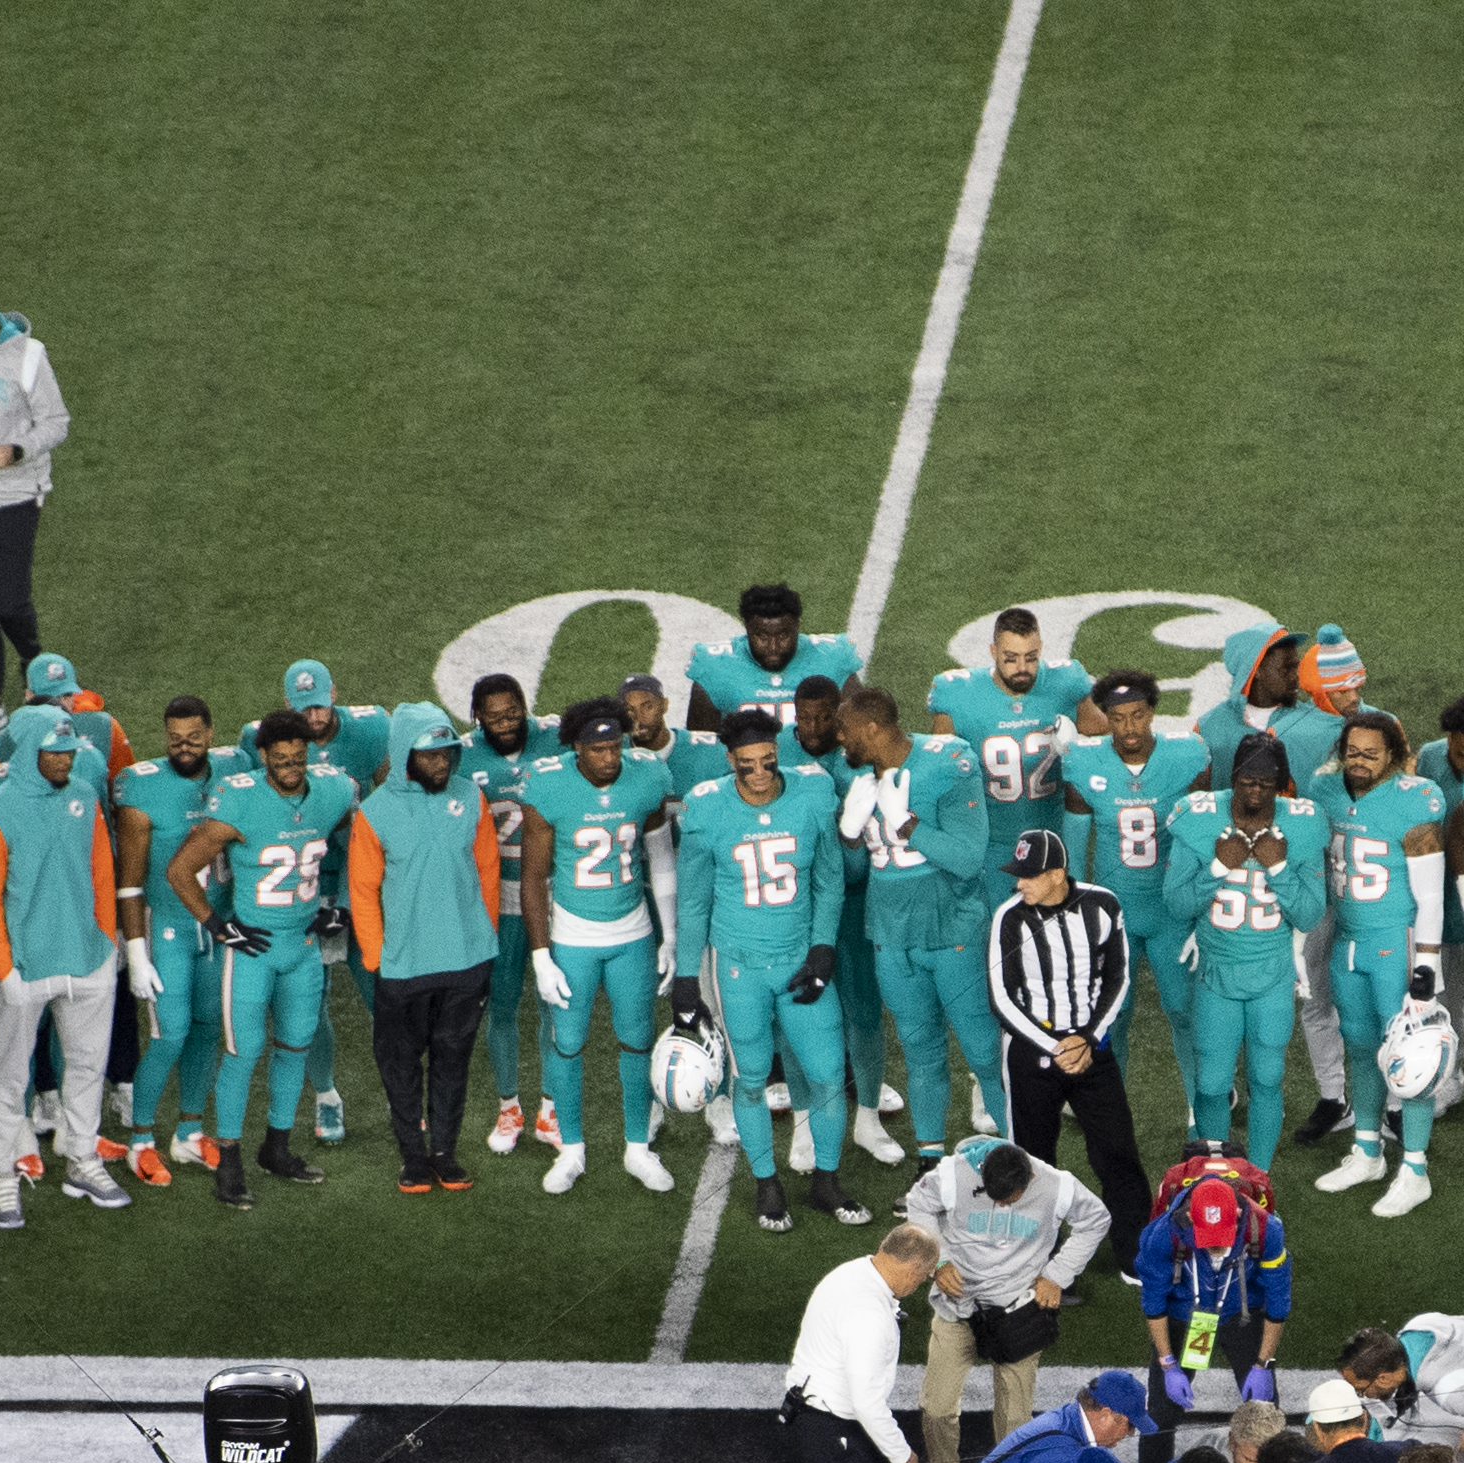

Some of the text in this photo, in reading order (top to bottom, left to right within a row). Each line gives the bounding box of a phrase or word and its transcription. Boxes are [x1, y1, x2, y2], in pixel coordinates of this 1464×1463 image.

[997, 718, 1041, 730] Dolphins
[983, 731, 1063, 802] 92
[1089, 774, 1108, 791] C
[573, 821, 638, 889] 21
[1116, 805, 1160, 869] 8
[1328, 831, 1390, 902] 45
[255, 837, 329, 907] 29
[732, 835, 798, 907] 15
[1218, 867, 1284, 931] 55
[1188, 1331, 1213, 1357] 4
[220, 1439, 261, 1450] SKYCAM
